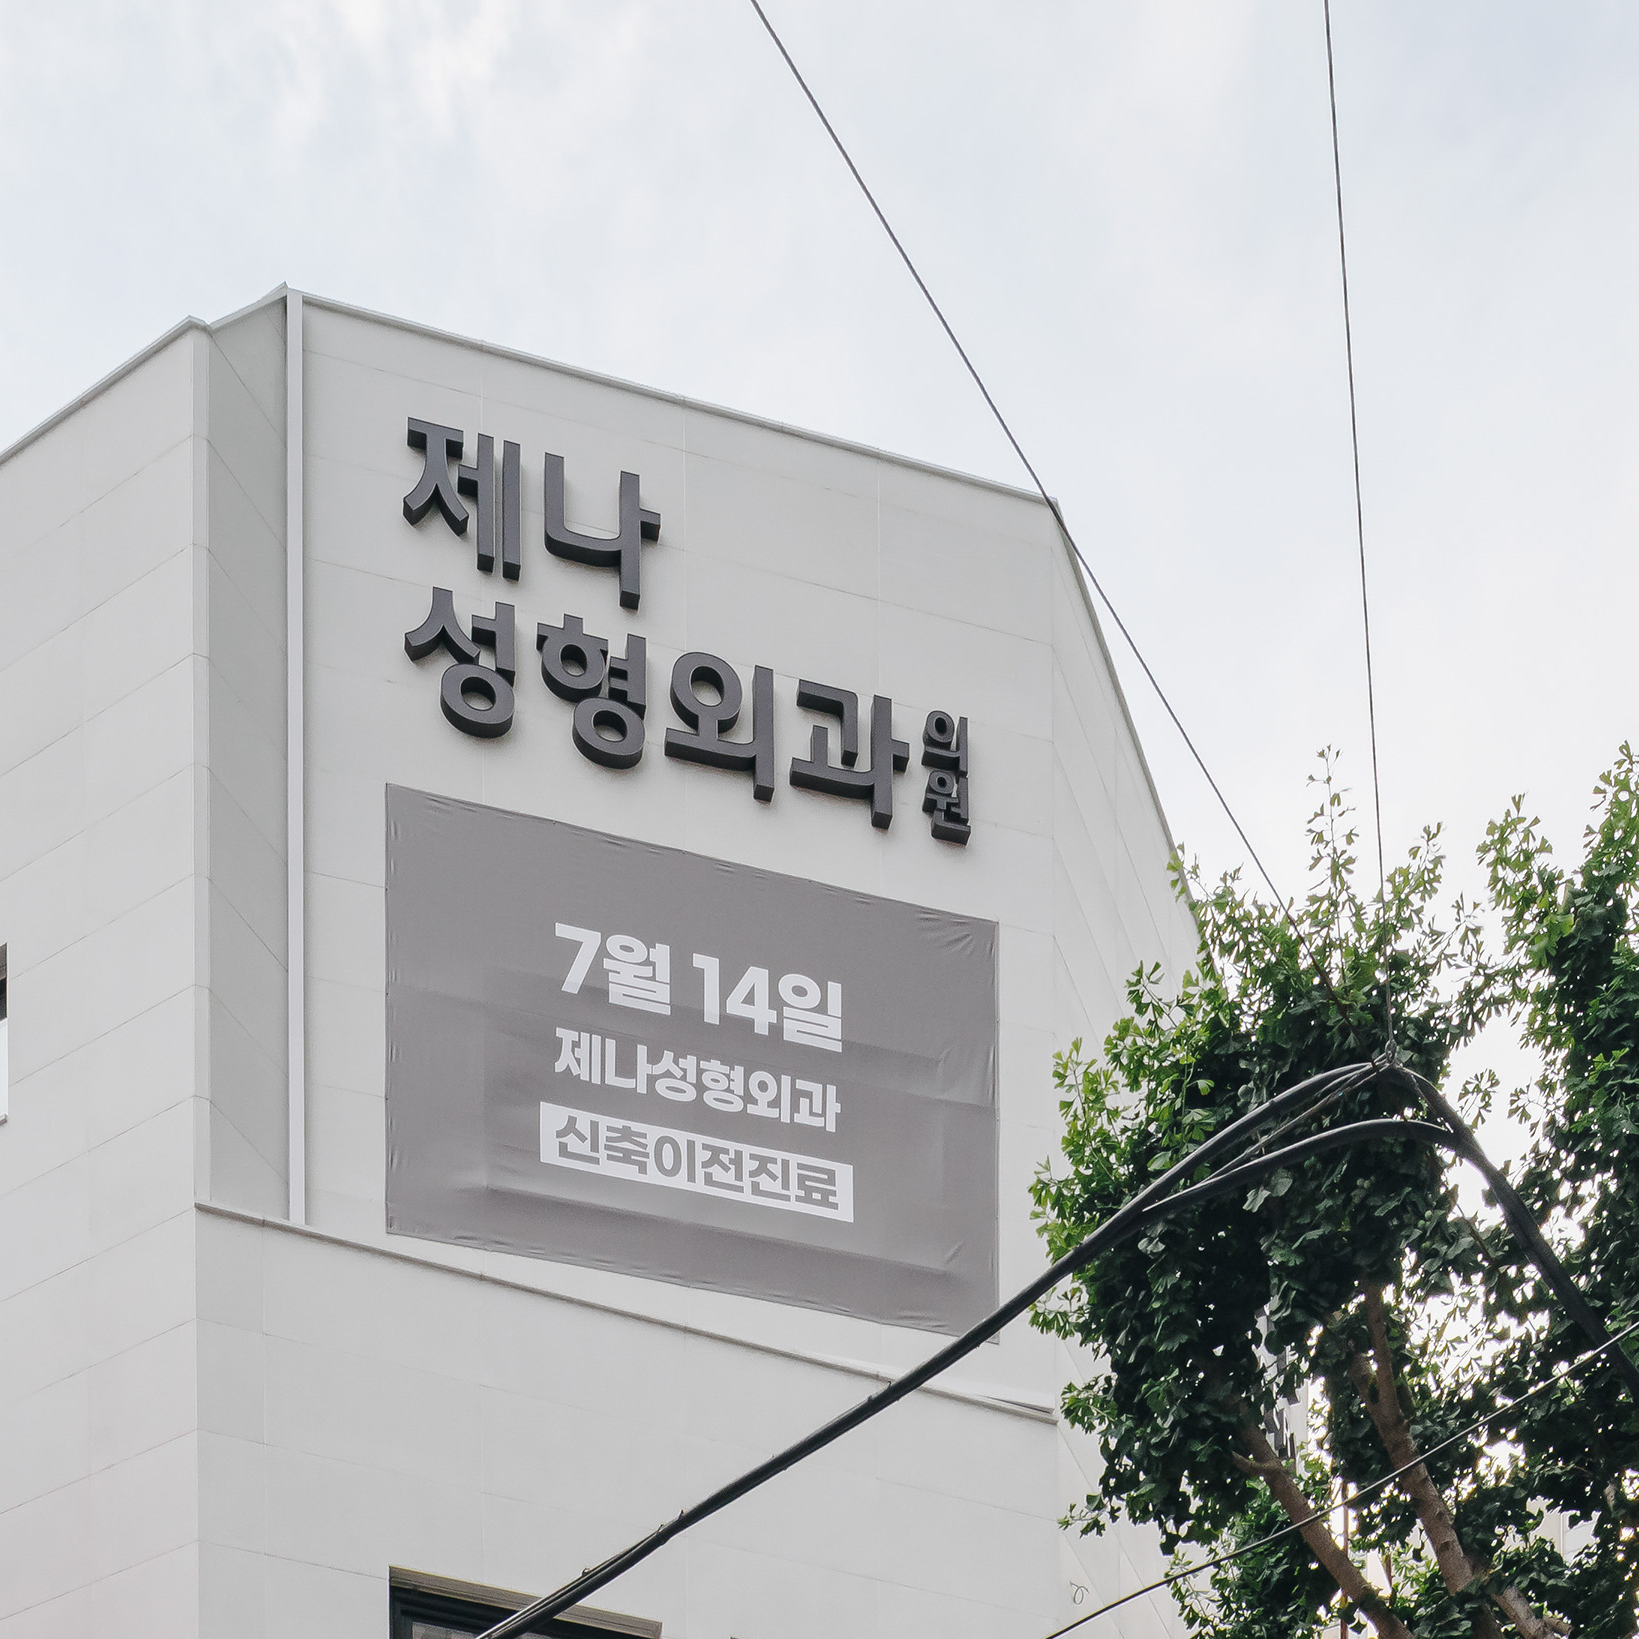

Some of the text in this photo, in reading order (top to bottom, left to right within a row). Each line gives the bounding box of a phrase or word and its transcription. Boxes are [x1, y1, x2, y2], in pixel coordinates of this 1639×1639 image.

[403, 416, 661, 609] 제나
[404, 587, 972, 847] 성형외과 의원
[555, 922, 844, 1053] 7월 14일
[554, 1027, 842, 1134] 제나성형외과
[555, 1112, 841, 1213] 신축이전진료
